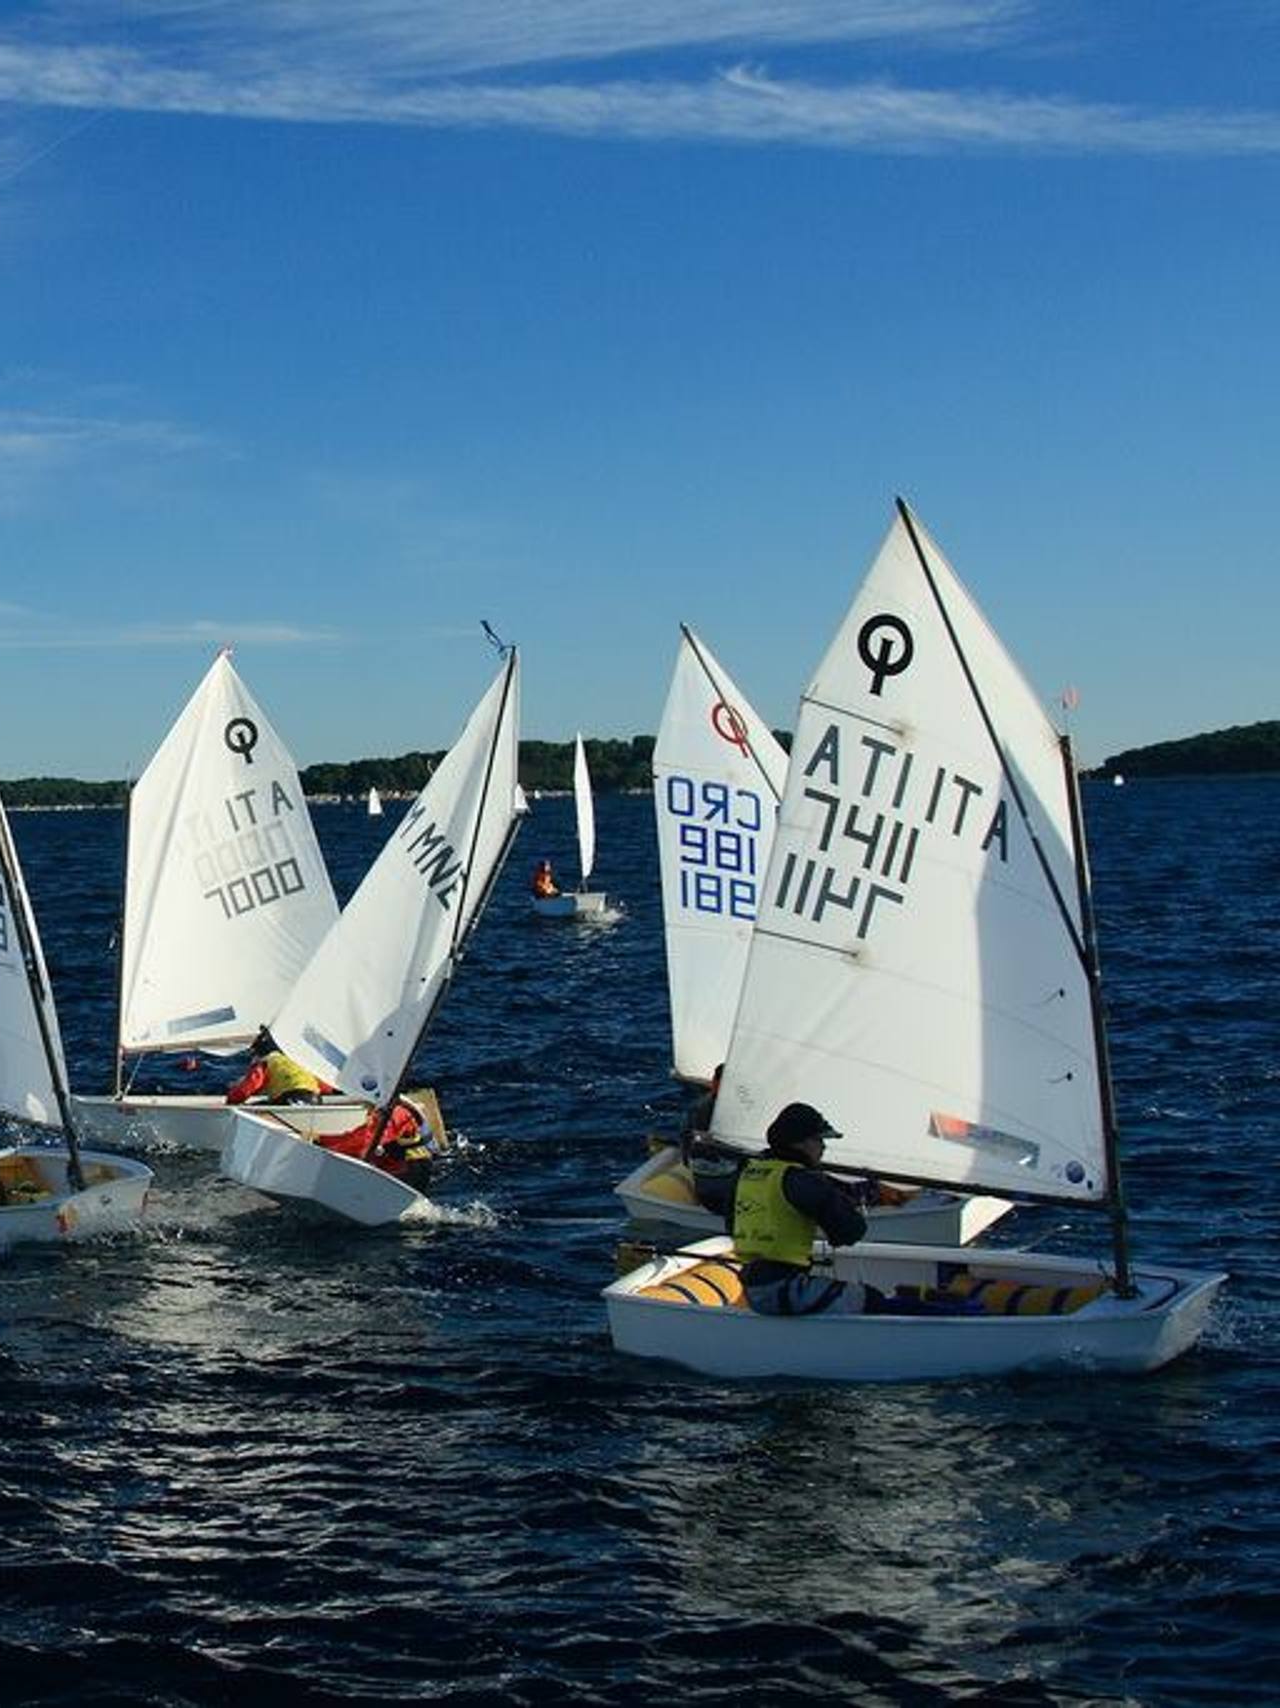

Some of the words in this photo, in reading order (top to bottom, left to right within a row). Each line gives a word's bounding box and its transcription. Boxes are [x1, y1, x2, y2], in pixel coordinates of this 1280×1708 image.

[225, 780, 294, 833] ITA
[804, 787, 920, 884] 7411
[925, 766, 1008, 862] ITA
[680, 823, 757, 876] 981
[204, 858, 306, 919] 7000
